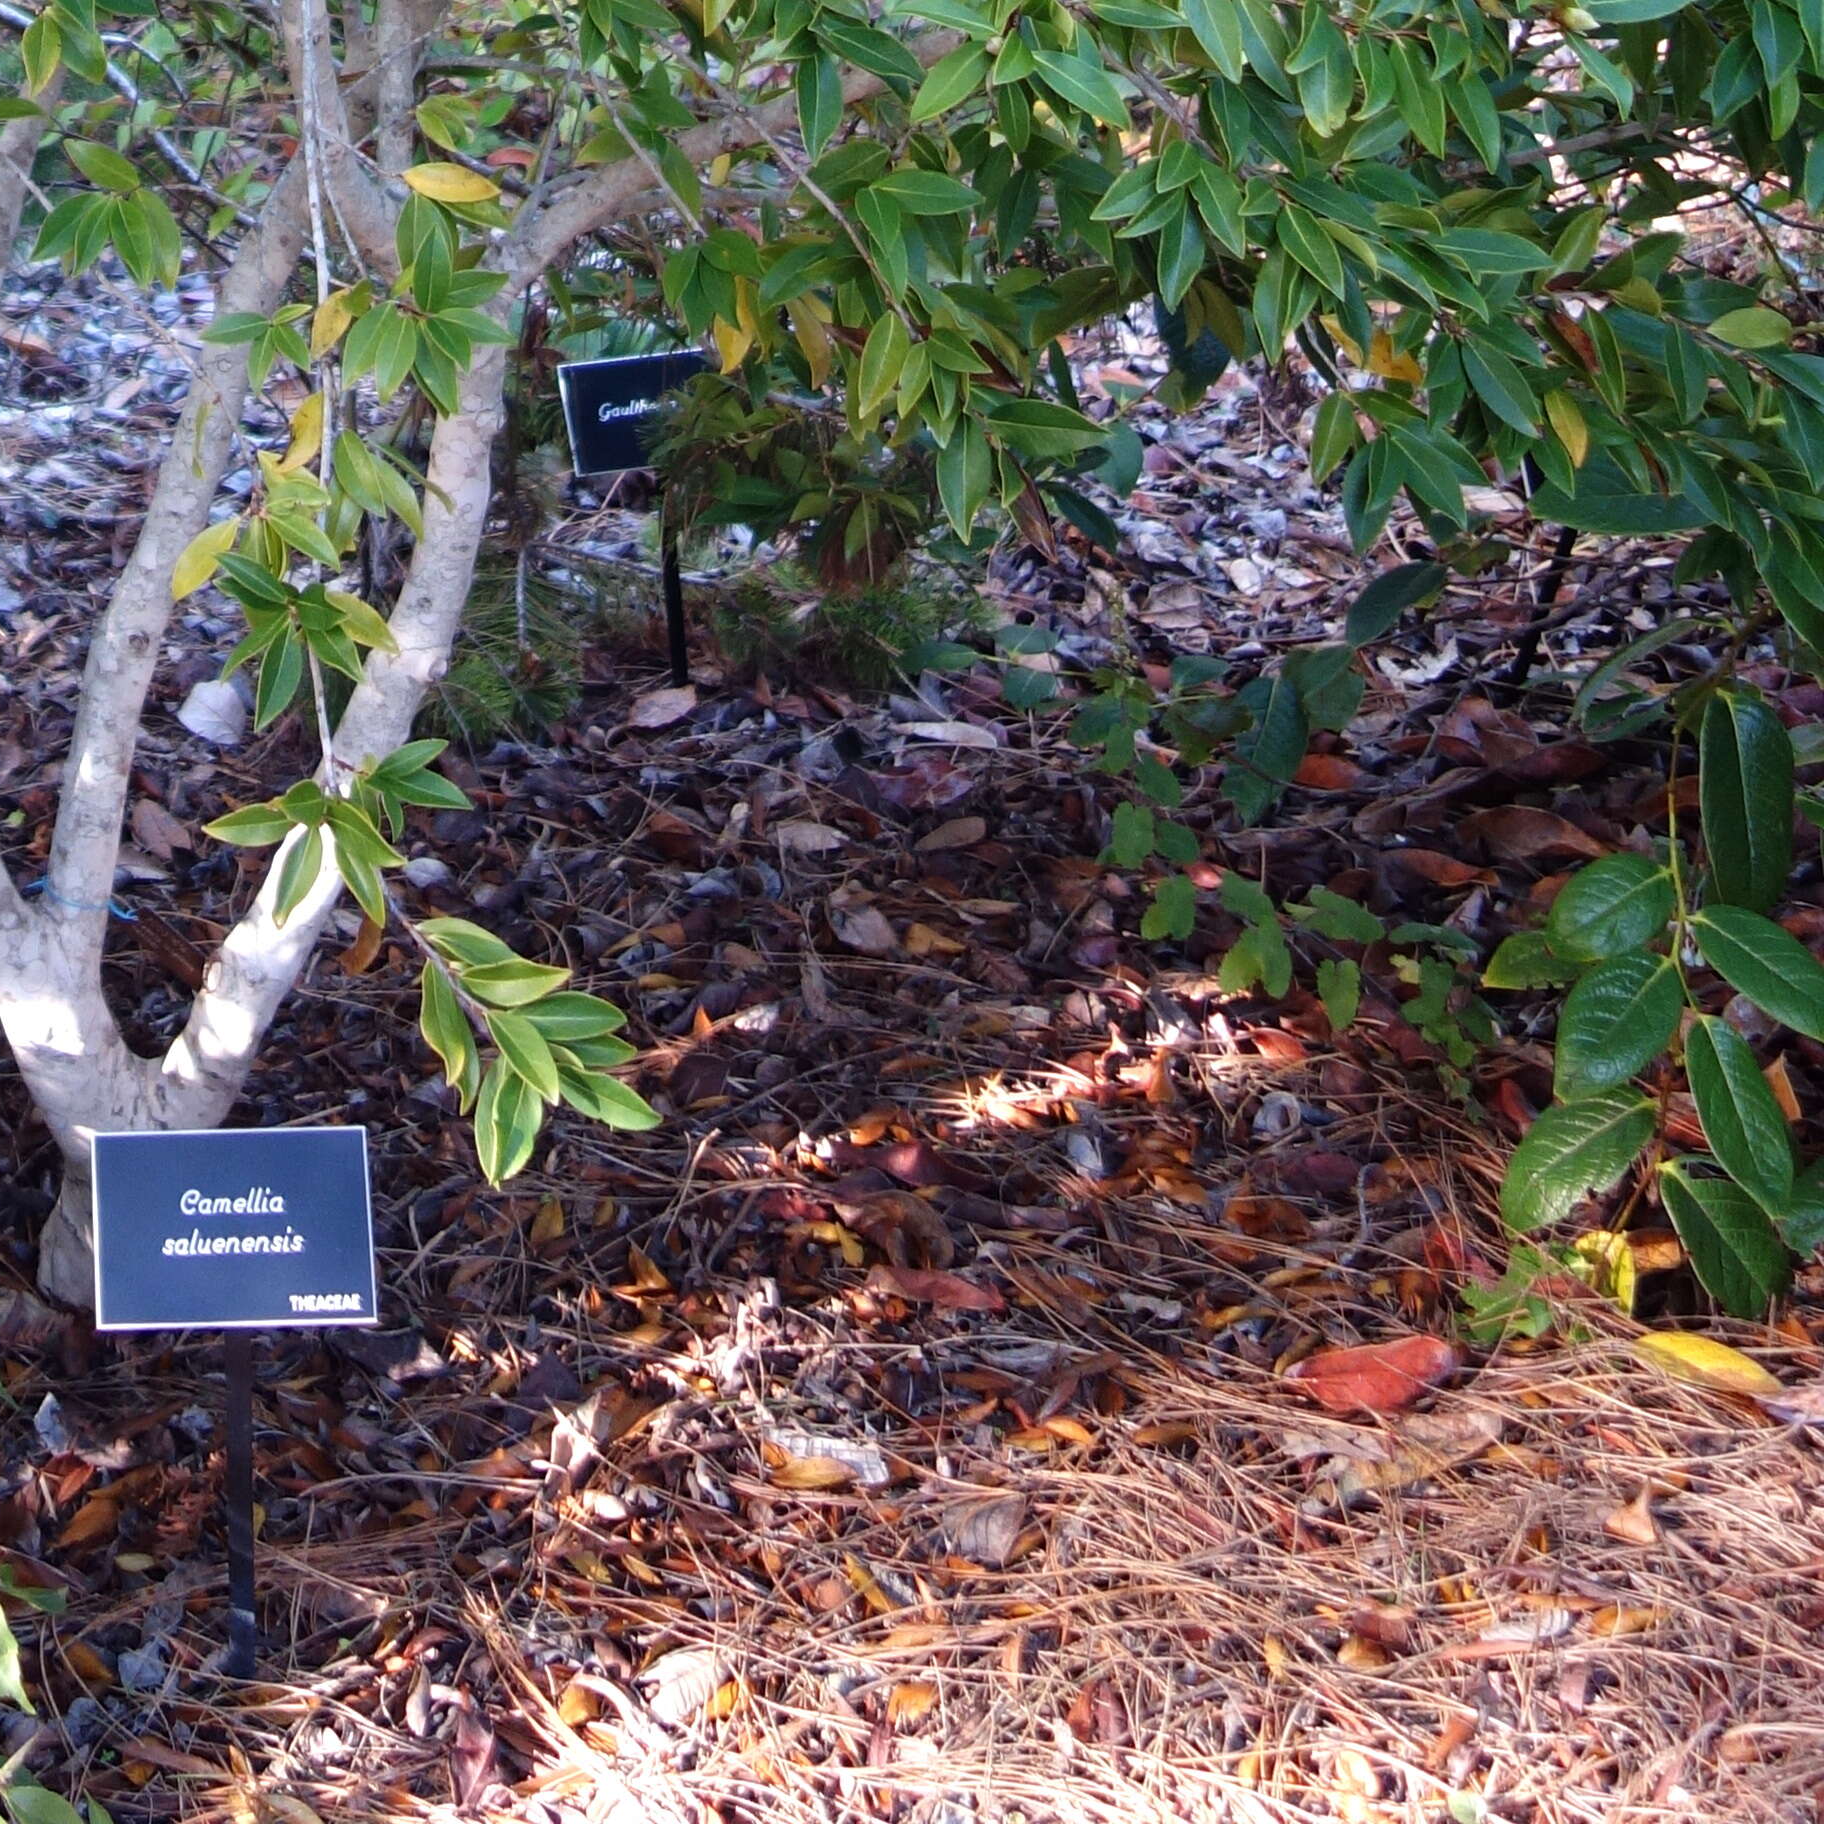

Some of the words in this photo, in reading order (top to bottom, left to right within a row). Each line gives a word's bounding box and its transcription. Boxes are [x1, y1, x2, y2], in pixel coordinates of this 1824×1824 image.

[180, 1187, 284, 1215] Camellia
[162, 1226, 305, 1256] saluenensis
[288, 1293, 362, 1311] THEACEAE
